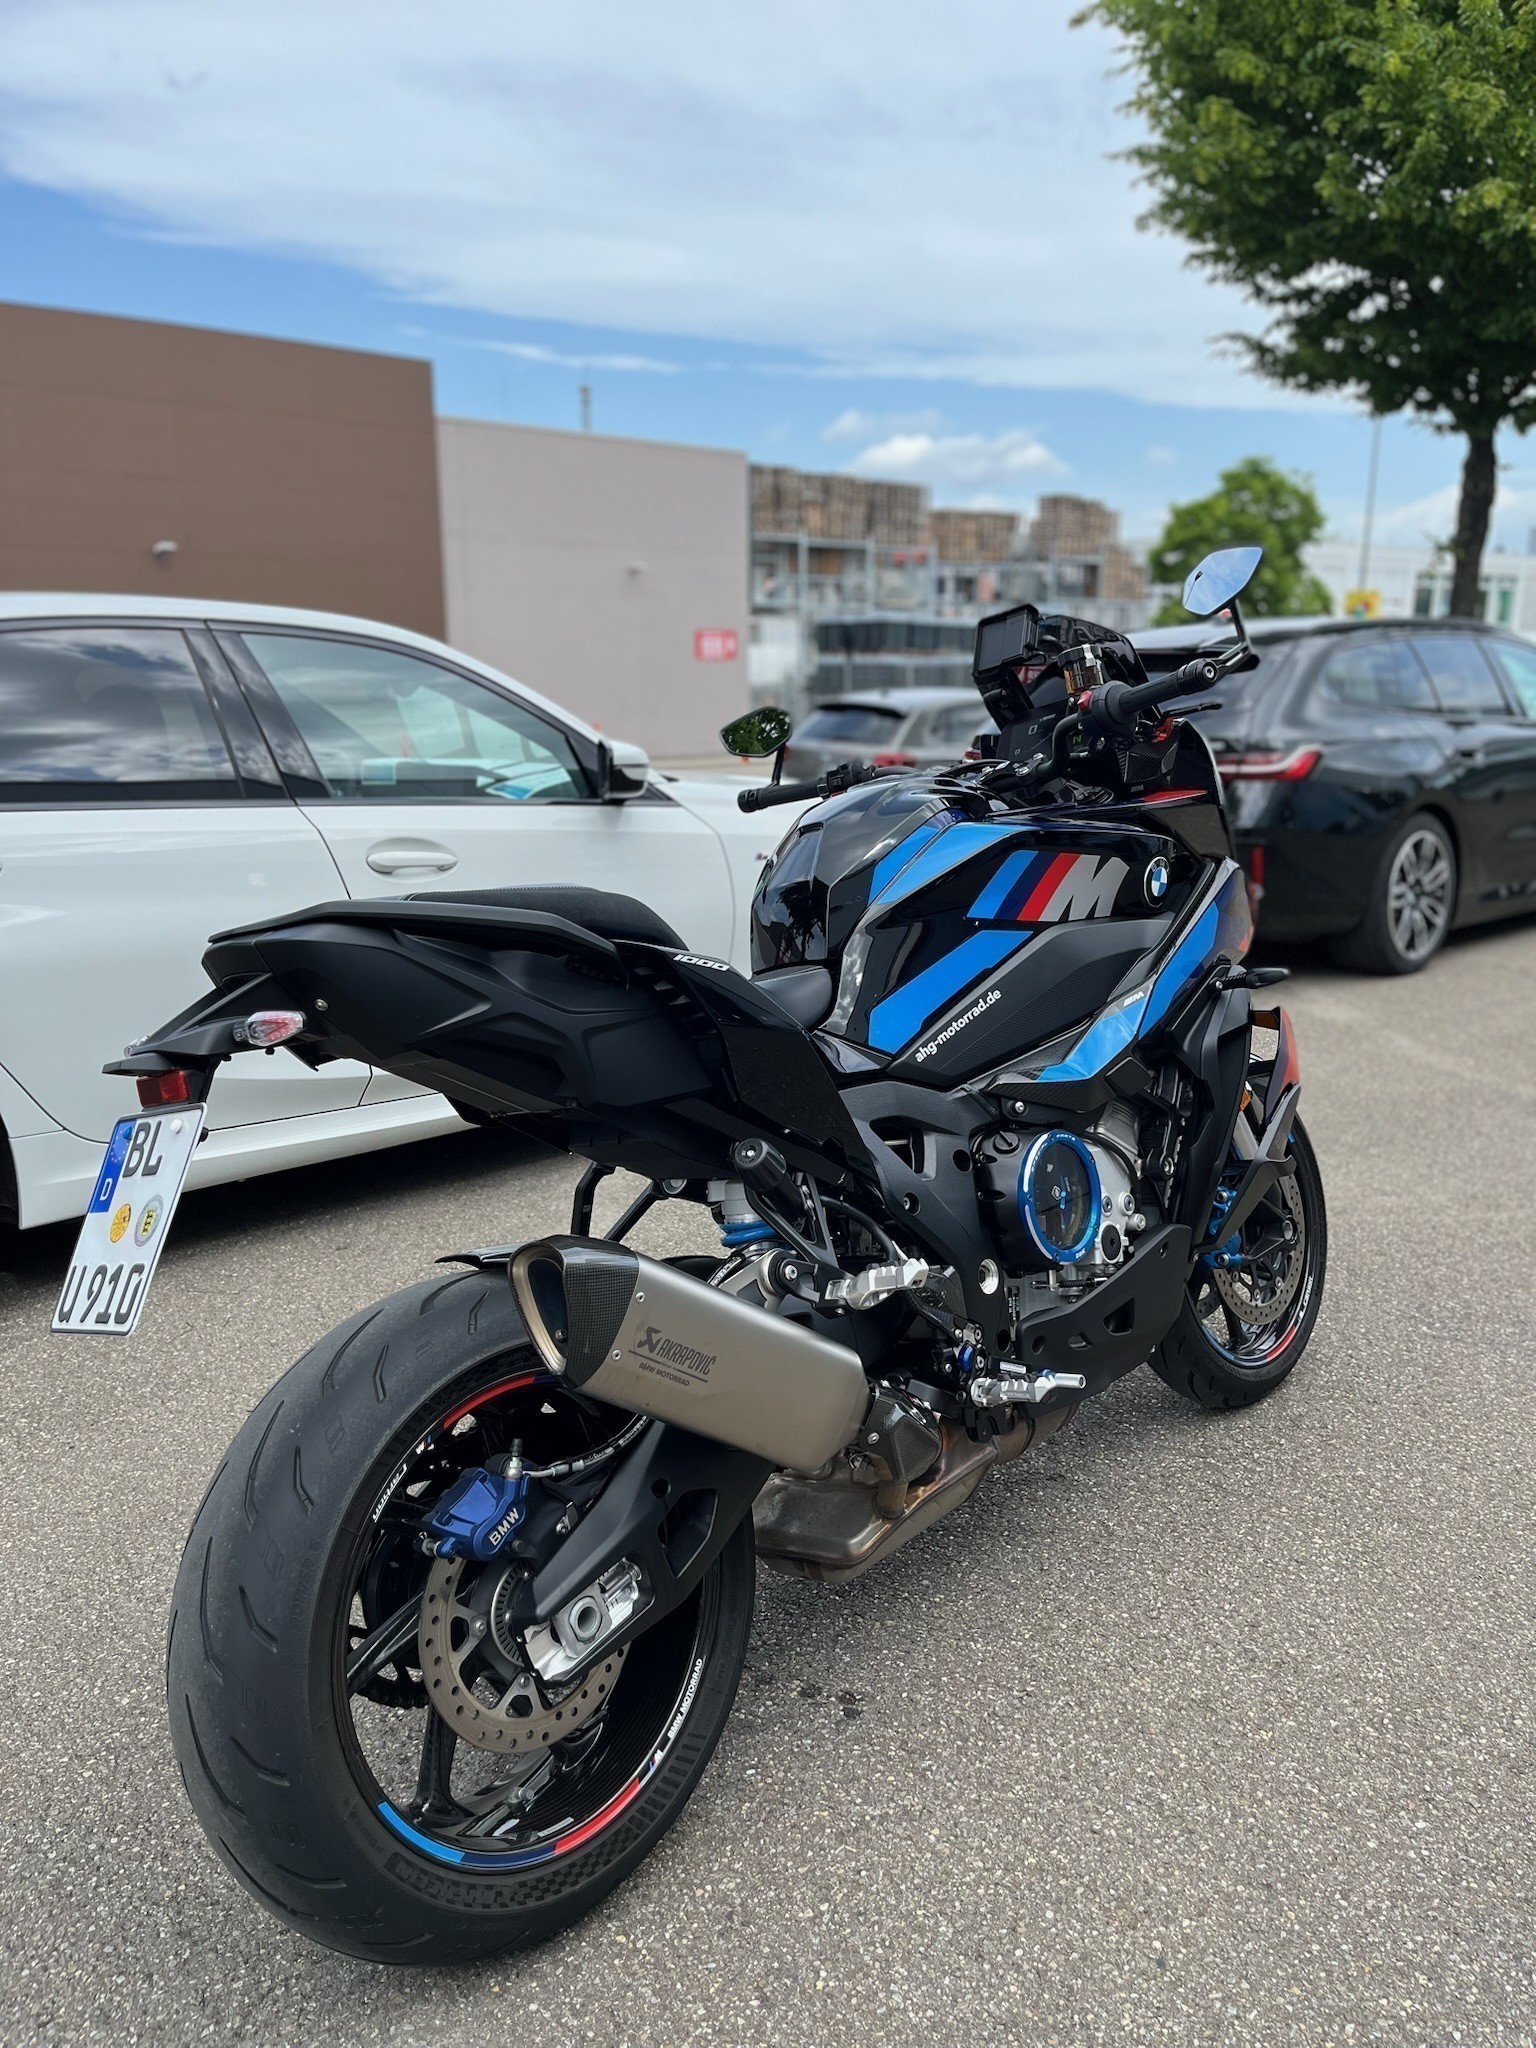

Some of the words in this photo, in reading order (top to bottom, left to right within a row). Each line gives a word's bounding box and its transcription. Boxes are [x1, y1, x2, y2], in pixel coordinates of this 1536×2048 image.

[1038, 854, 1130, 921] M
[673, 954, 730, 971] 1000
[915, 989, 1002, 1062] ahg-motorrad.de
[122, 1120, 163, 1178] BL
[99, 1178, 112, 1201] D
[79, 1263, 145, 1324] 910
[639, 1362, 656, 1373] BMW
[655, 1369, 690, 1386] MOTORRAD
[489, 1507, 519, 1546] BMW
[667, 1713, 682, 1740] BMW
[680, 1658, 702, 1715] MOTORRAD
